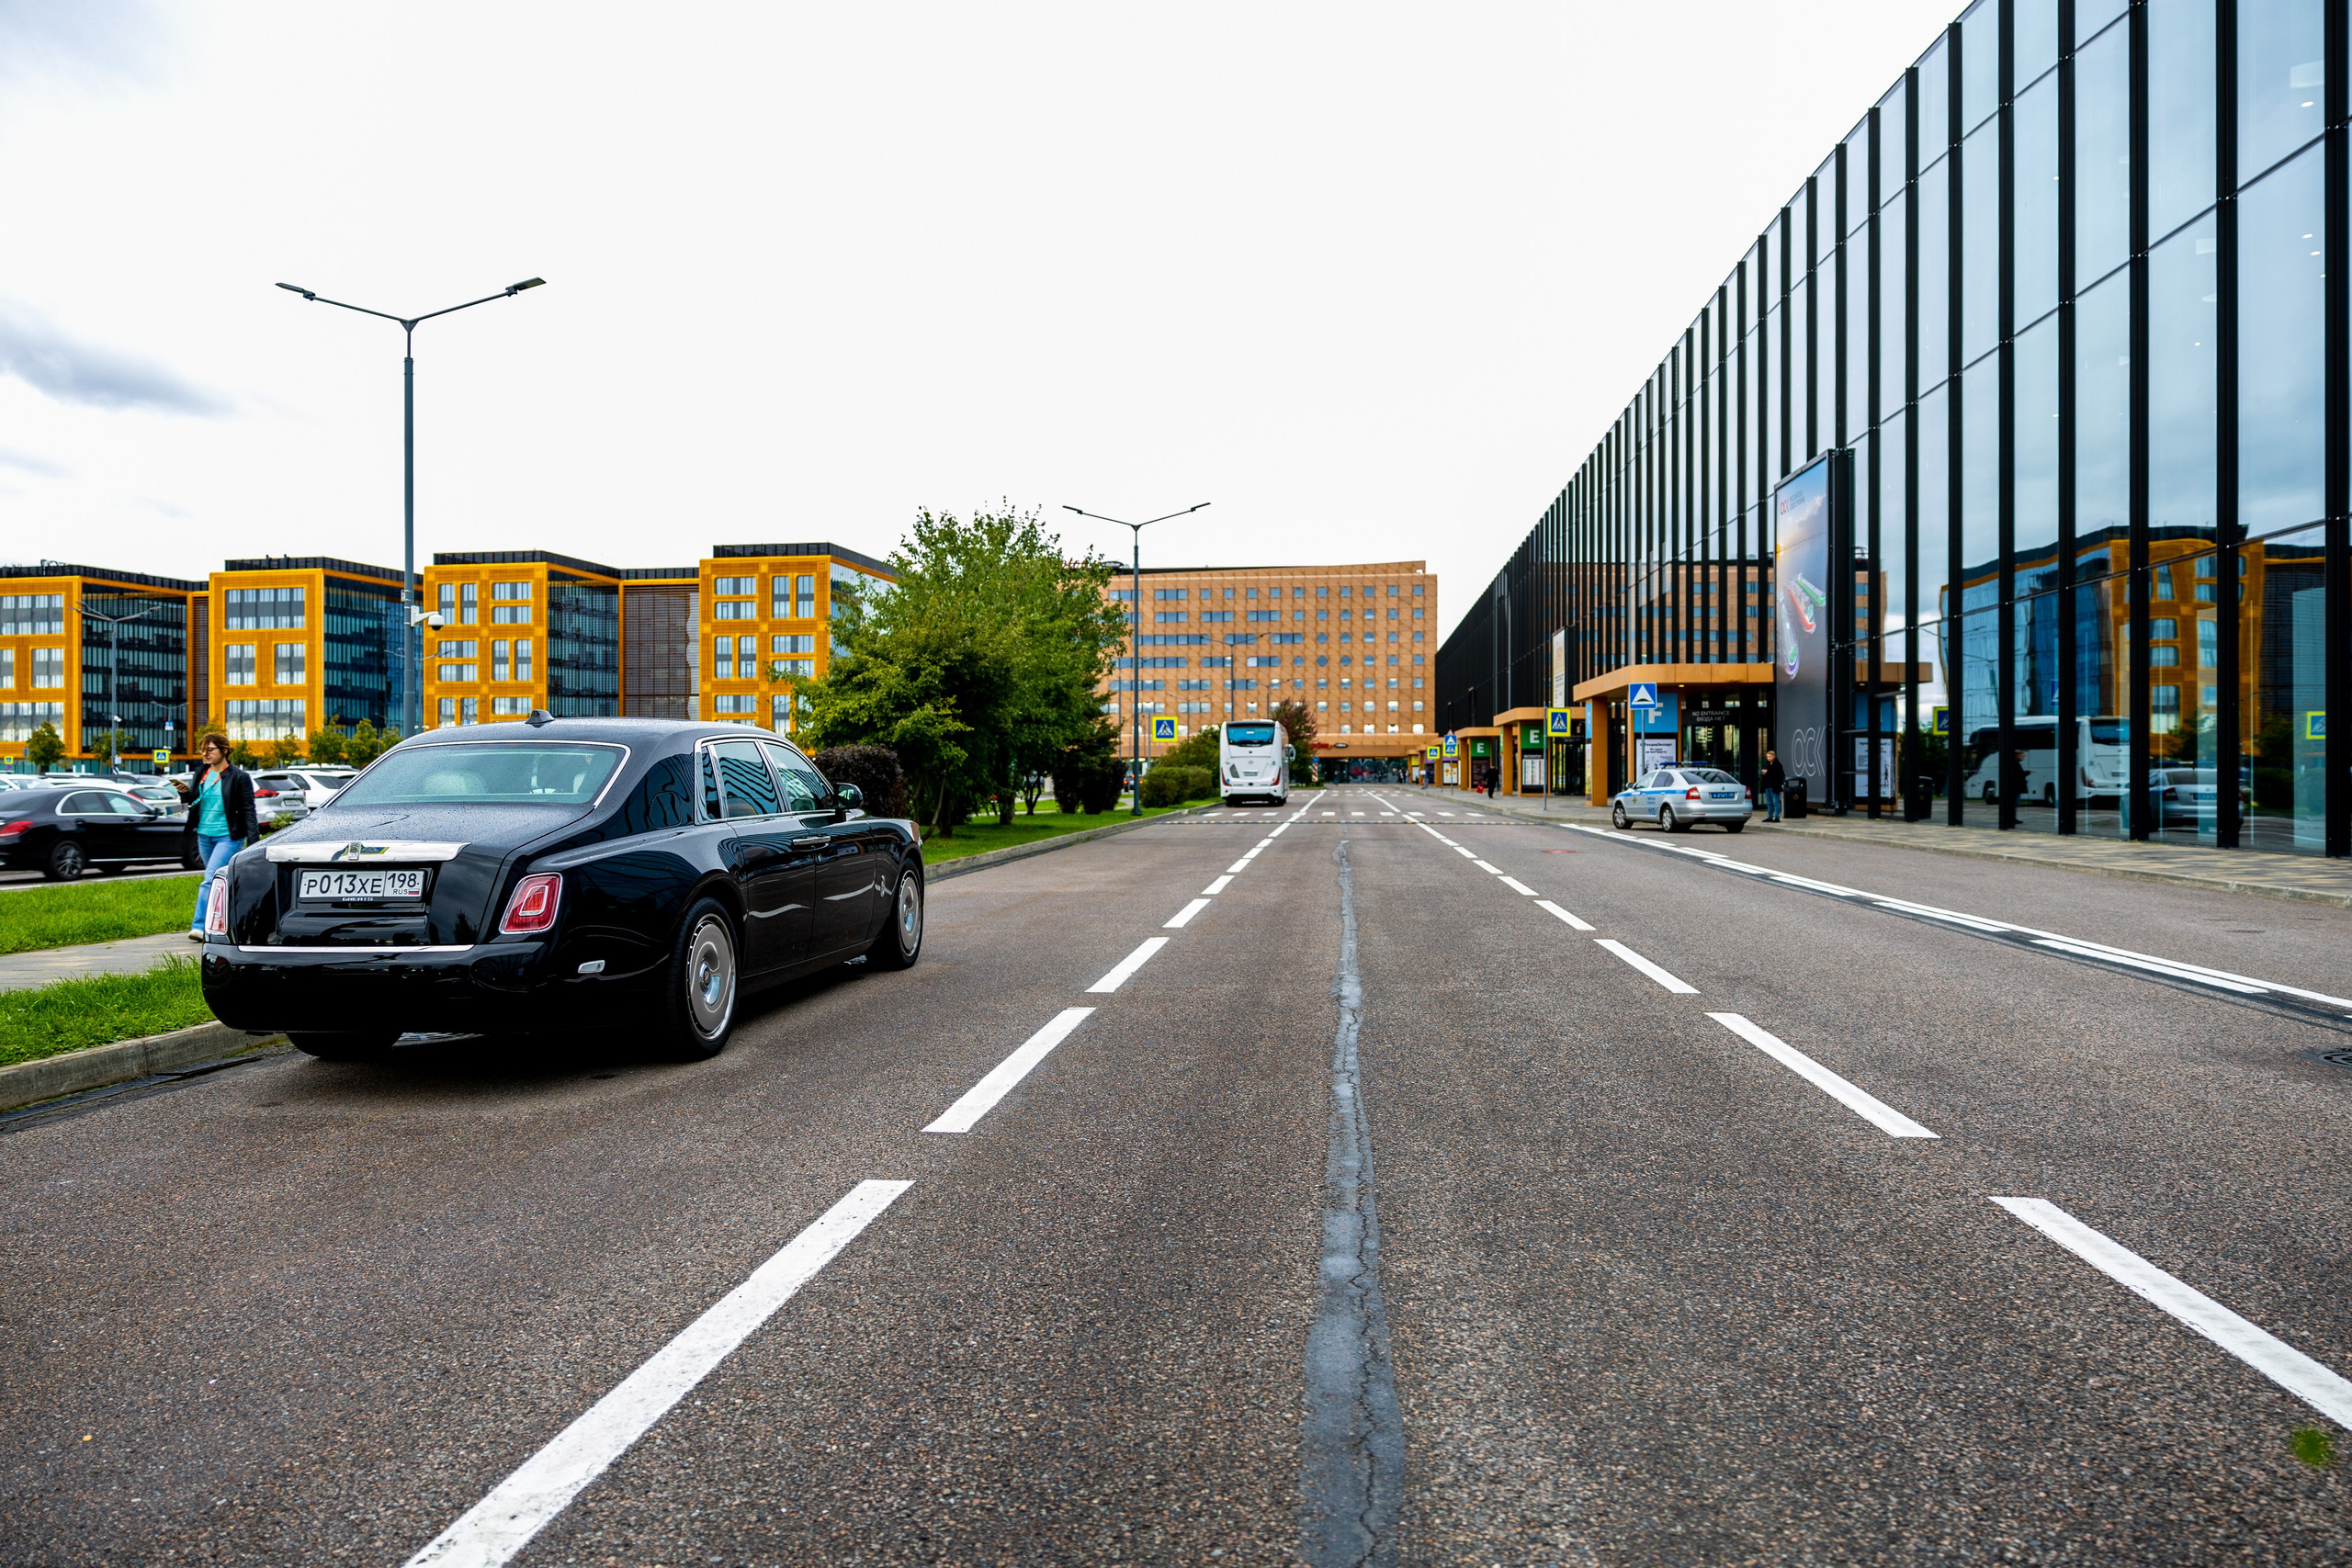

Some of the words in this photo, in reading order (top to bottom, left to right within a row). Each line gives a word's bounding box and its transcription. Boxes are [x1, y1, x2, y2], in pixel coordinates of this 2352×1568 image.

[1648, 702, 1664, 724] F
[1530, 729, 1540, 743] E
[1476, 742, 1485, 753] E
[387, 873, 417, 888] 198
